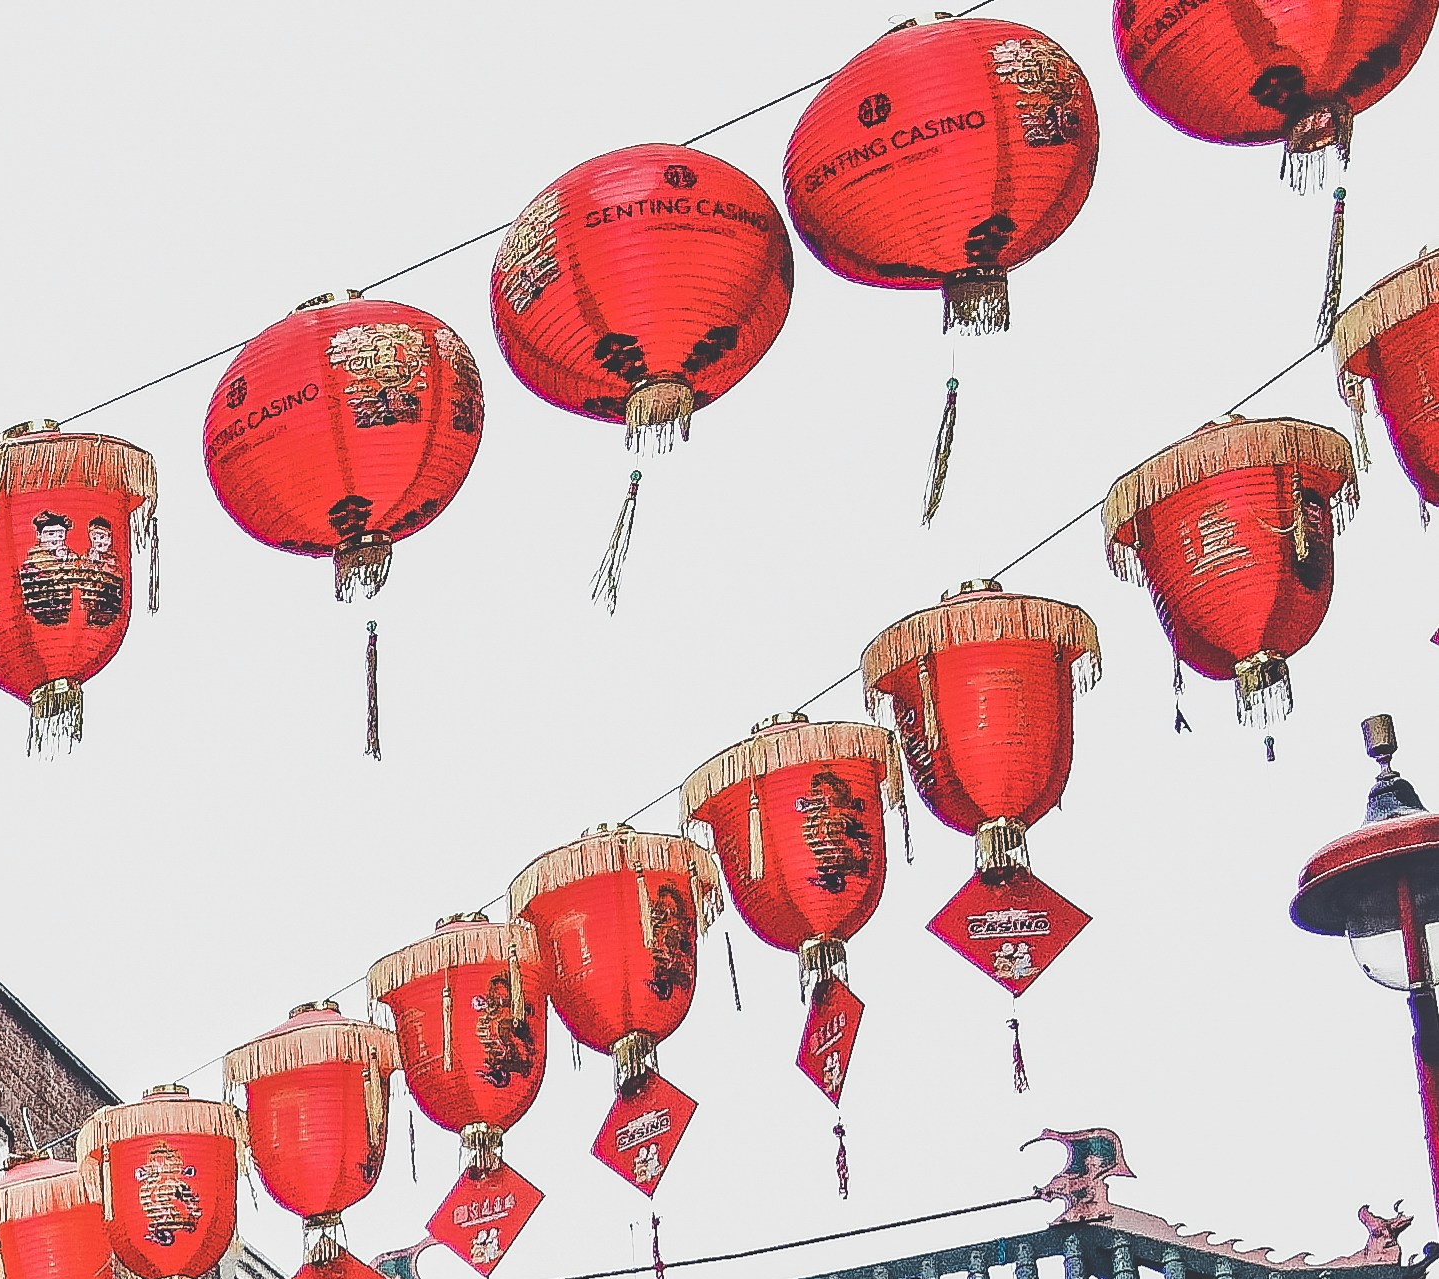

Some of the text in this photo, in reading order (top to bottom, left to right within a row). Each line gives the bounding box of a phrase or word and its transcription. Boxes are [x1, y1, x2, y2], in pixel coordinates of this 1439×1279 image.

[890, 110, 986, 149] CASINO
[247, 382, 320, 430] CASINO
[967, 915, 1050, 937] CASINO
[616, 1114, 671, 1147] CASINO
